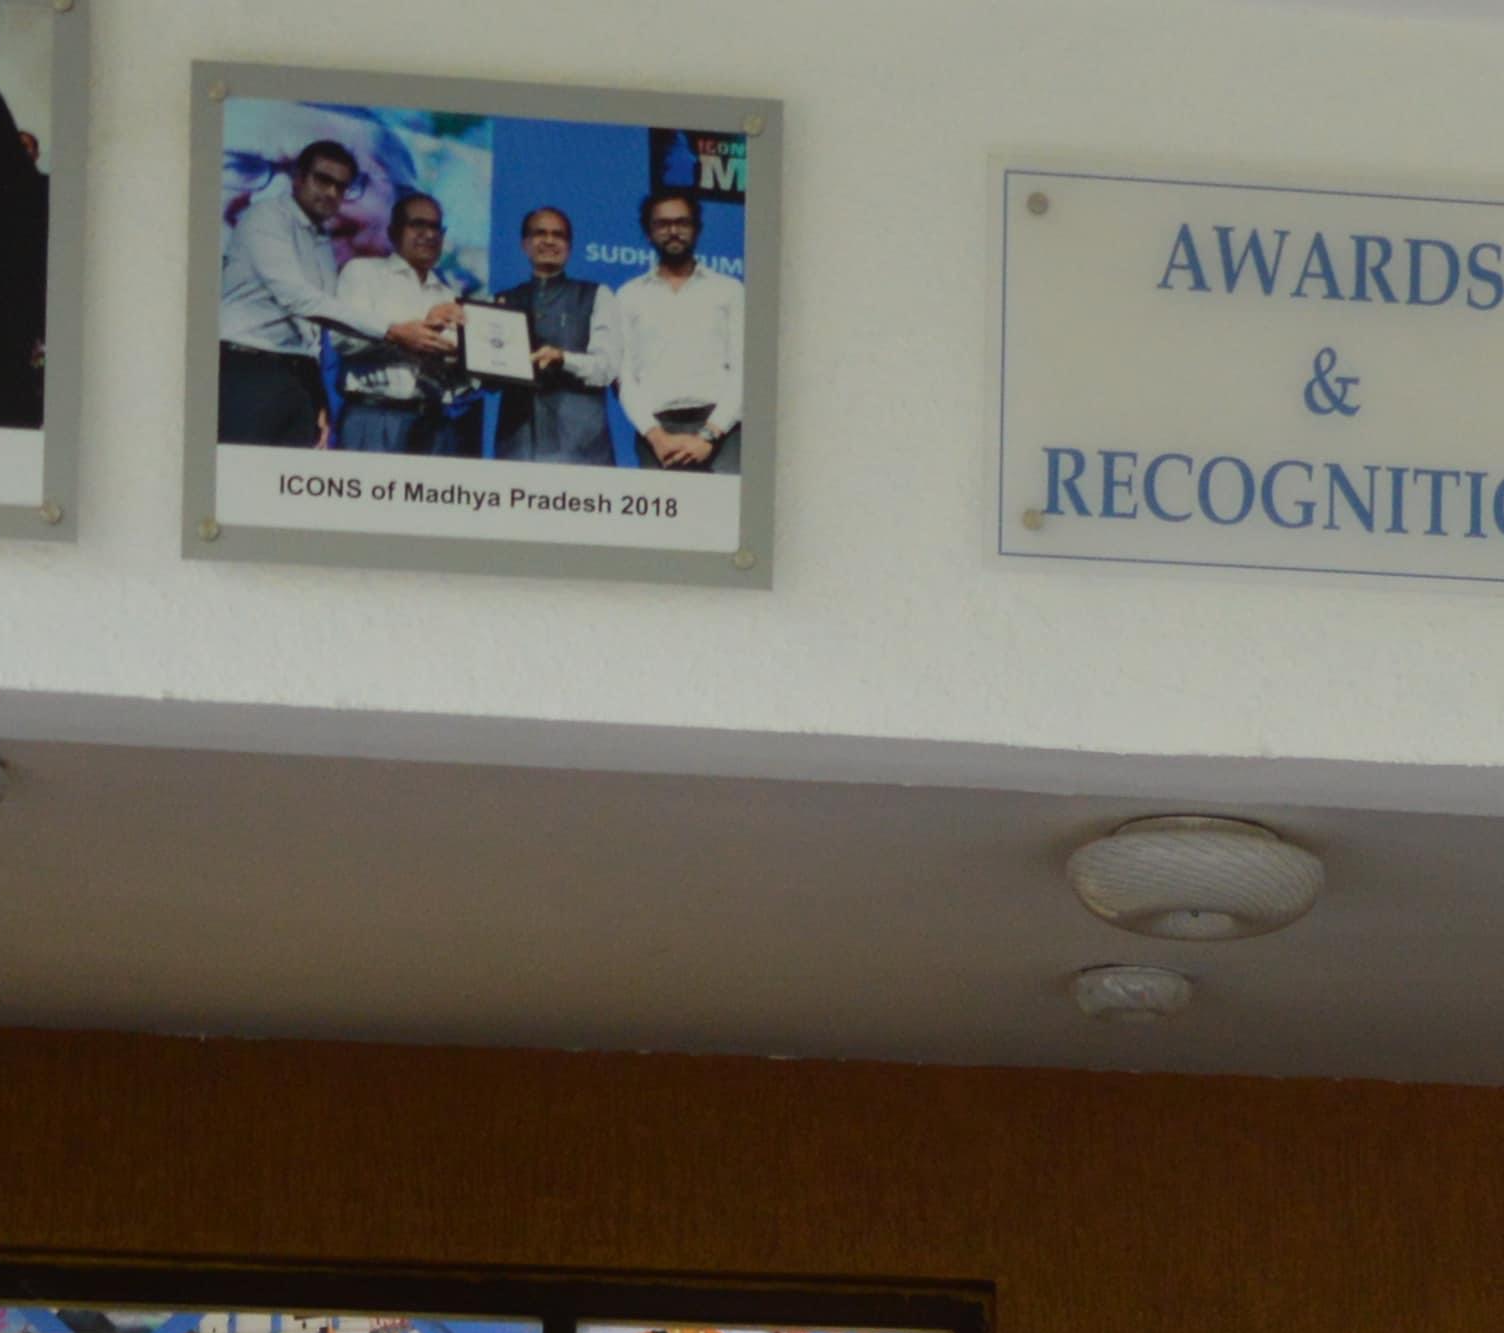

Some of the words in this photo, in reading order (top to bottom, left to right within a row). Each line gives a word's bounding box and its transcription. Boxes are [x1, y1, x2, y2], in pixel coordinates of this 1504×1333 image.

[1302, 346, 1361, 417] &
[279, 474, 363, 500] ICONS
[370, 479, 396, 501] of
[403, 481, 501, 511] Madhya
[510, 488, 613, 516] Pradesh
[620, 494, 679, 519] 2018
